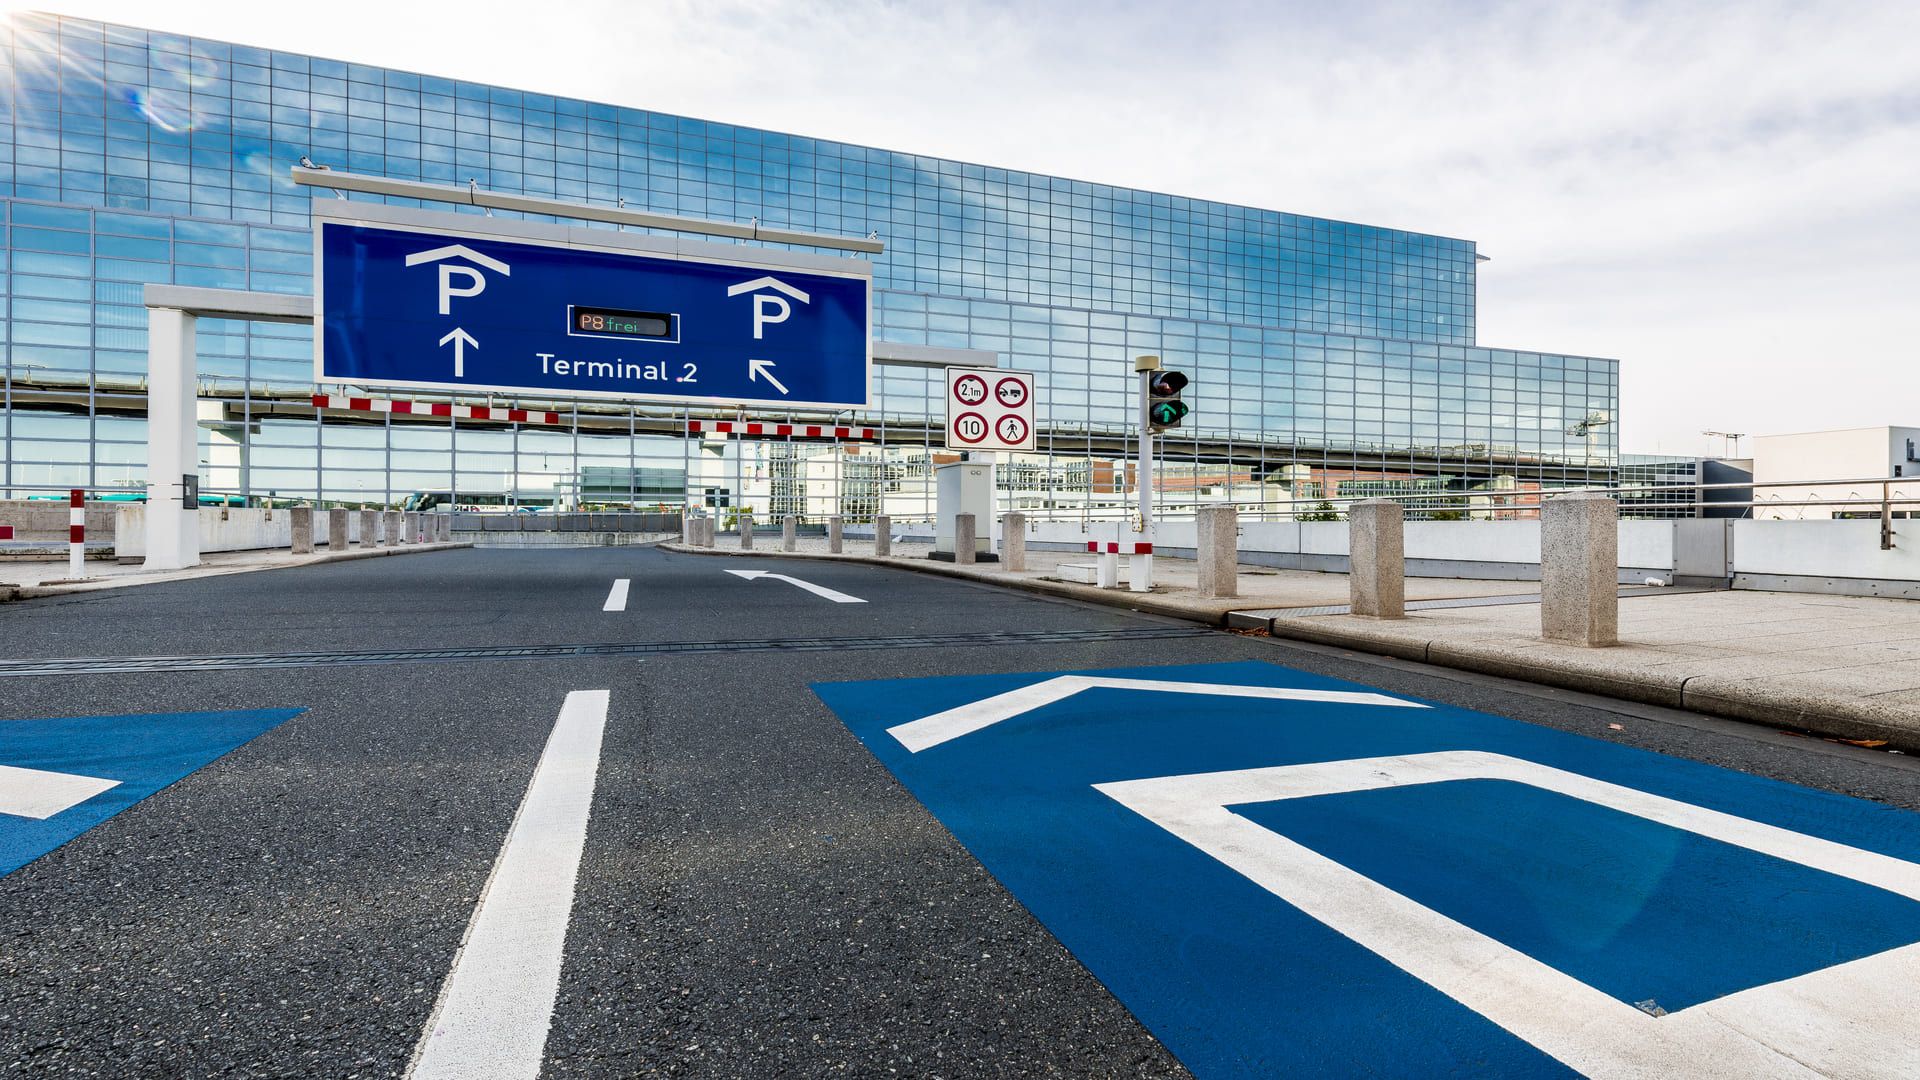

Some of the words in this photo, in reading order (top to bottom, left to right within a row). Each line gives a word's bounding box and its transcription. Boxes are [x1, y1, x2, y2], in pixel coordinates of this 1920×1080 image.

[438, 264, 486, 315] P
[581, 314, 604, 330] P8
[606, 317, 637, 333] frei
[753, 294, 791, 340] P
[535, 352, 668, 381] Terminal
[962, 420, 980, 435] 10
